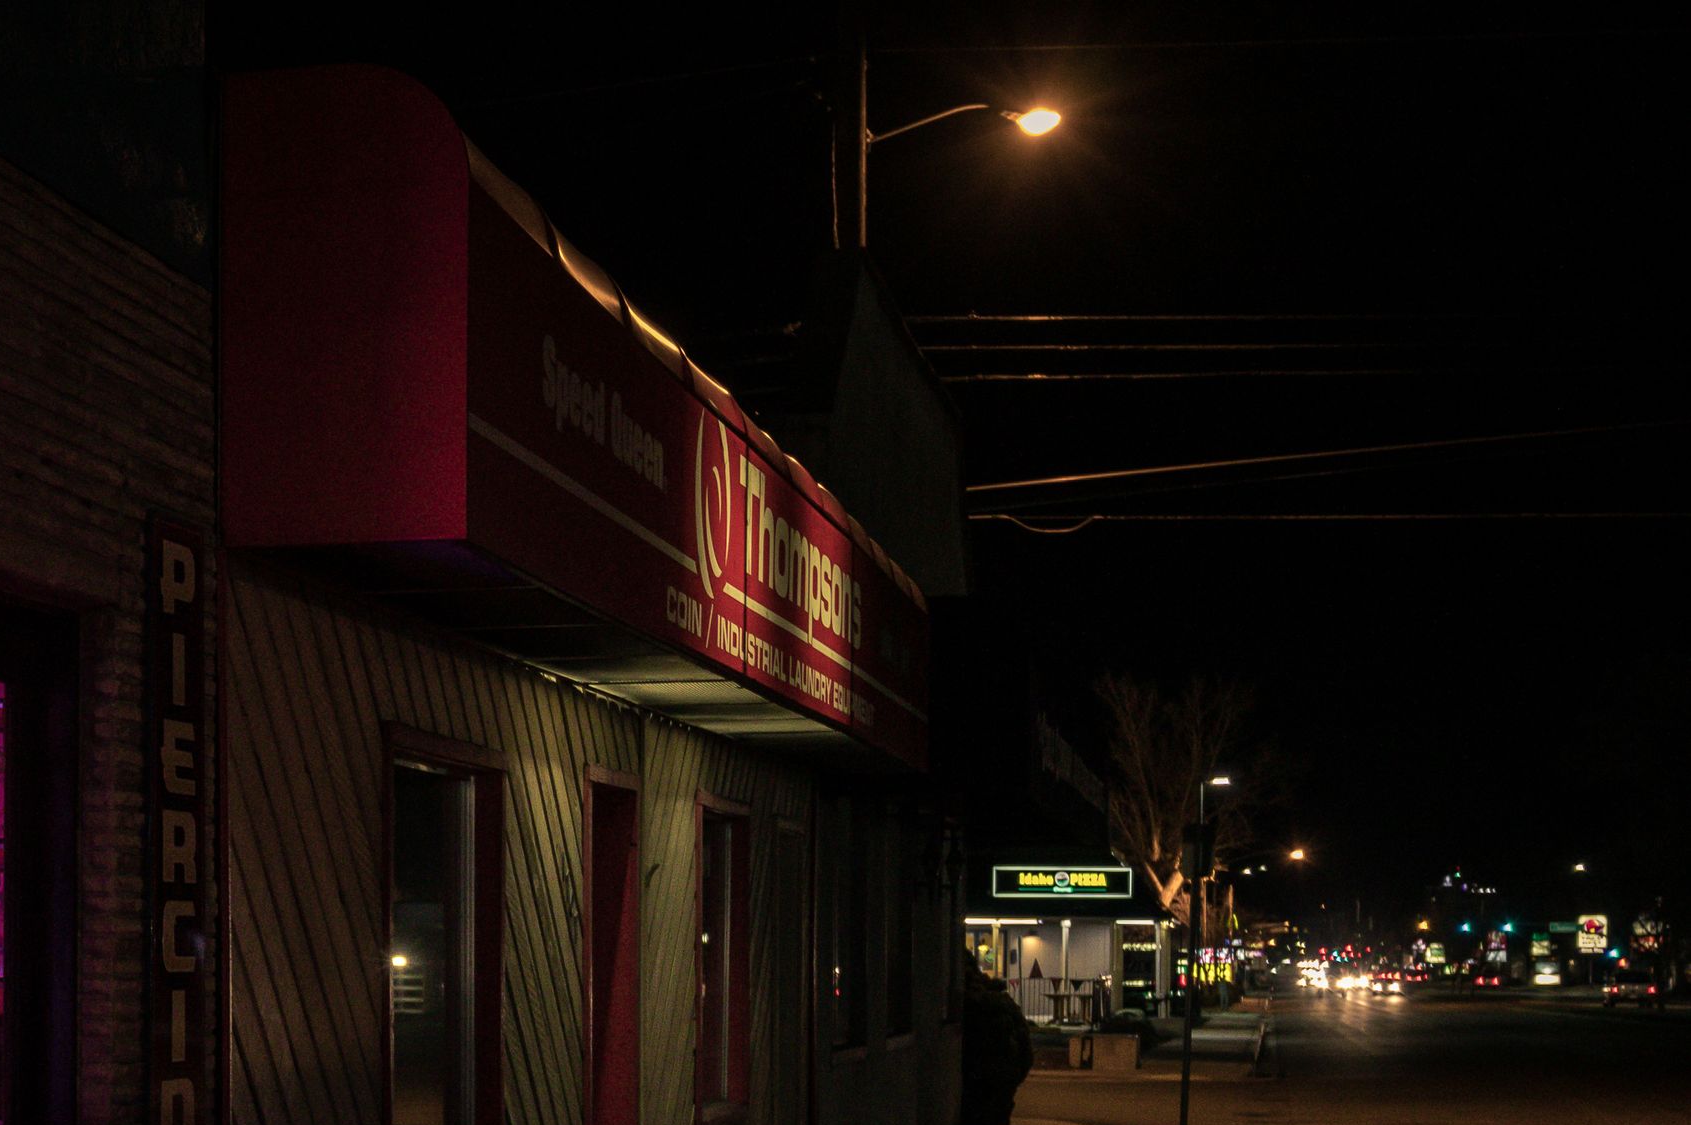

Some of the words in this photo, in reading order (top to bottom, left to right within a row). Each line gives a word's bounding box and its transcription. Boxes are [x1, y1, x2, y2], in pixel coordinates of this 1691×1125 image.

[666, 585, 703, 638] COIN
[717, 614, 786, 683] INDUSTRIAL
[789, 655, 832, 705] LAUNDRY
[1070, 873, 1107, 887] PIZZA
